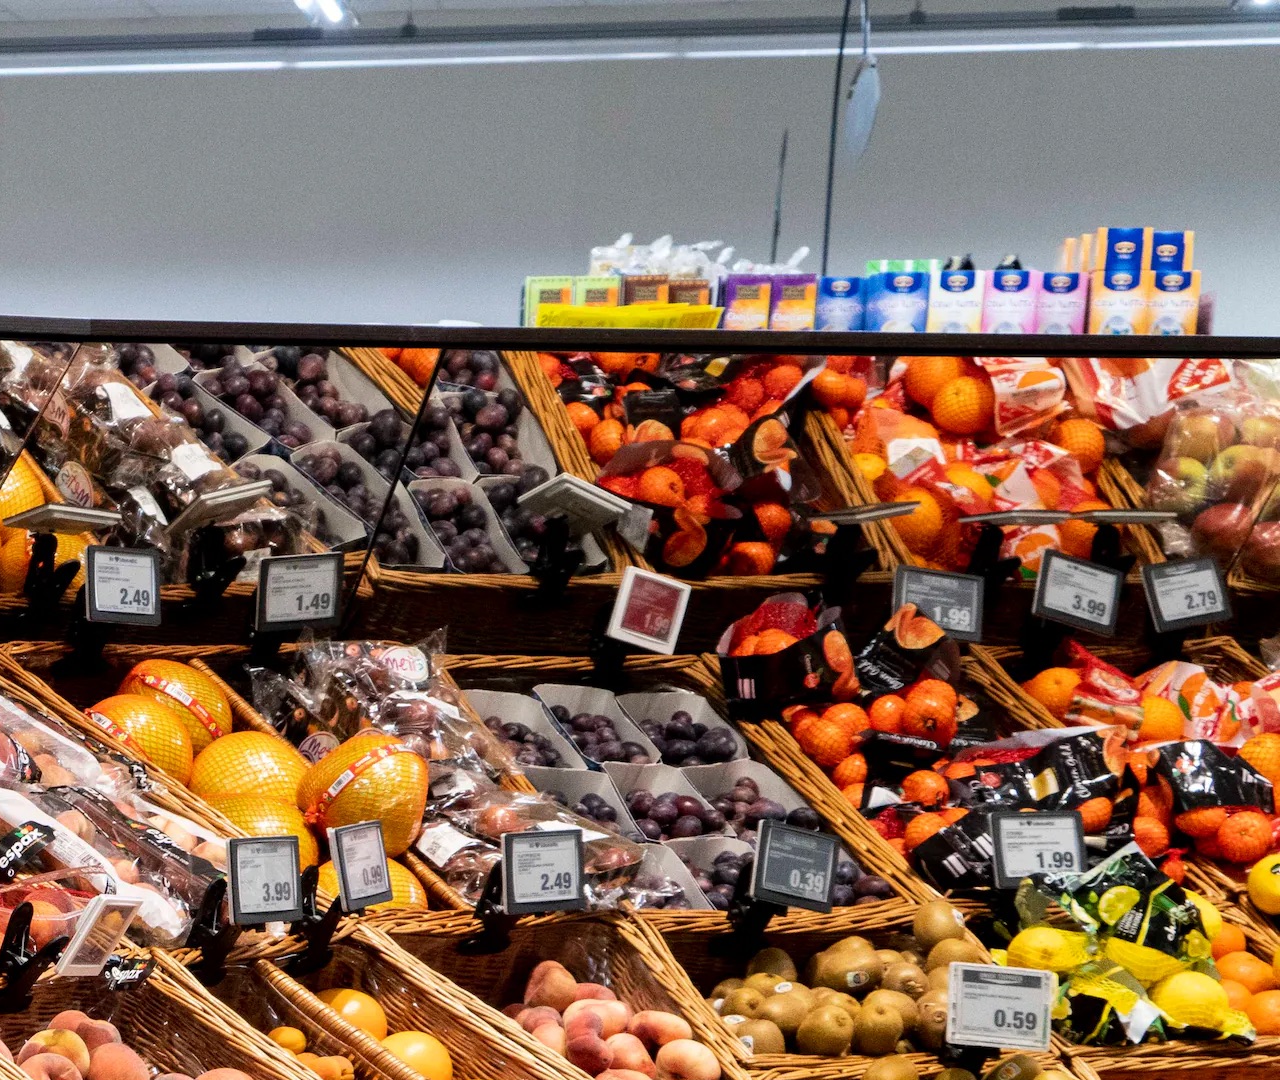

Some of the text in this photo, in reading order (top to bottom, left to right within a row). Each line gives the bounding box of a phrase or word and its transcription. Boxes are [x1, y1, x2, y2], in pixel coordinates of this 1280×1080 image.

[120, 588, 150, 607] 2.49
[296, 593, 330, 612] 1.49
[1072, 594, 1107, 618] 3.99
[1184, 590, 1218, 610] 2.79
[933, 606, 971, 626] 1.99
[1037, 851, 1074, 869] 1.99
[363, 865, 382, 886] 0.99
[541, 872, 572, 891] 2.49
[790, 869, 824, 893] 0.39
[263, 882, 291, 902] 3.99
[993, 1009, 1037, 1031] 0.59
